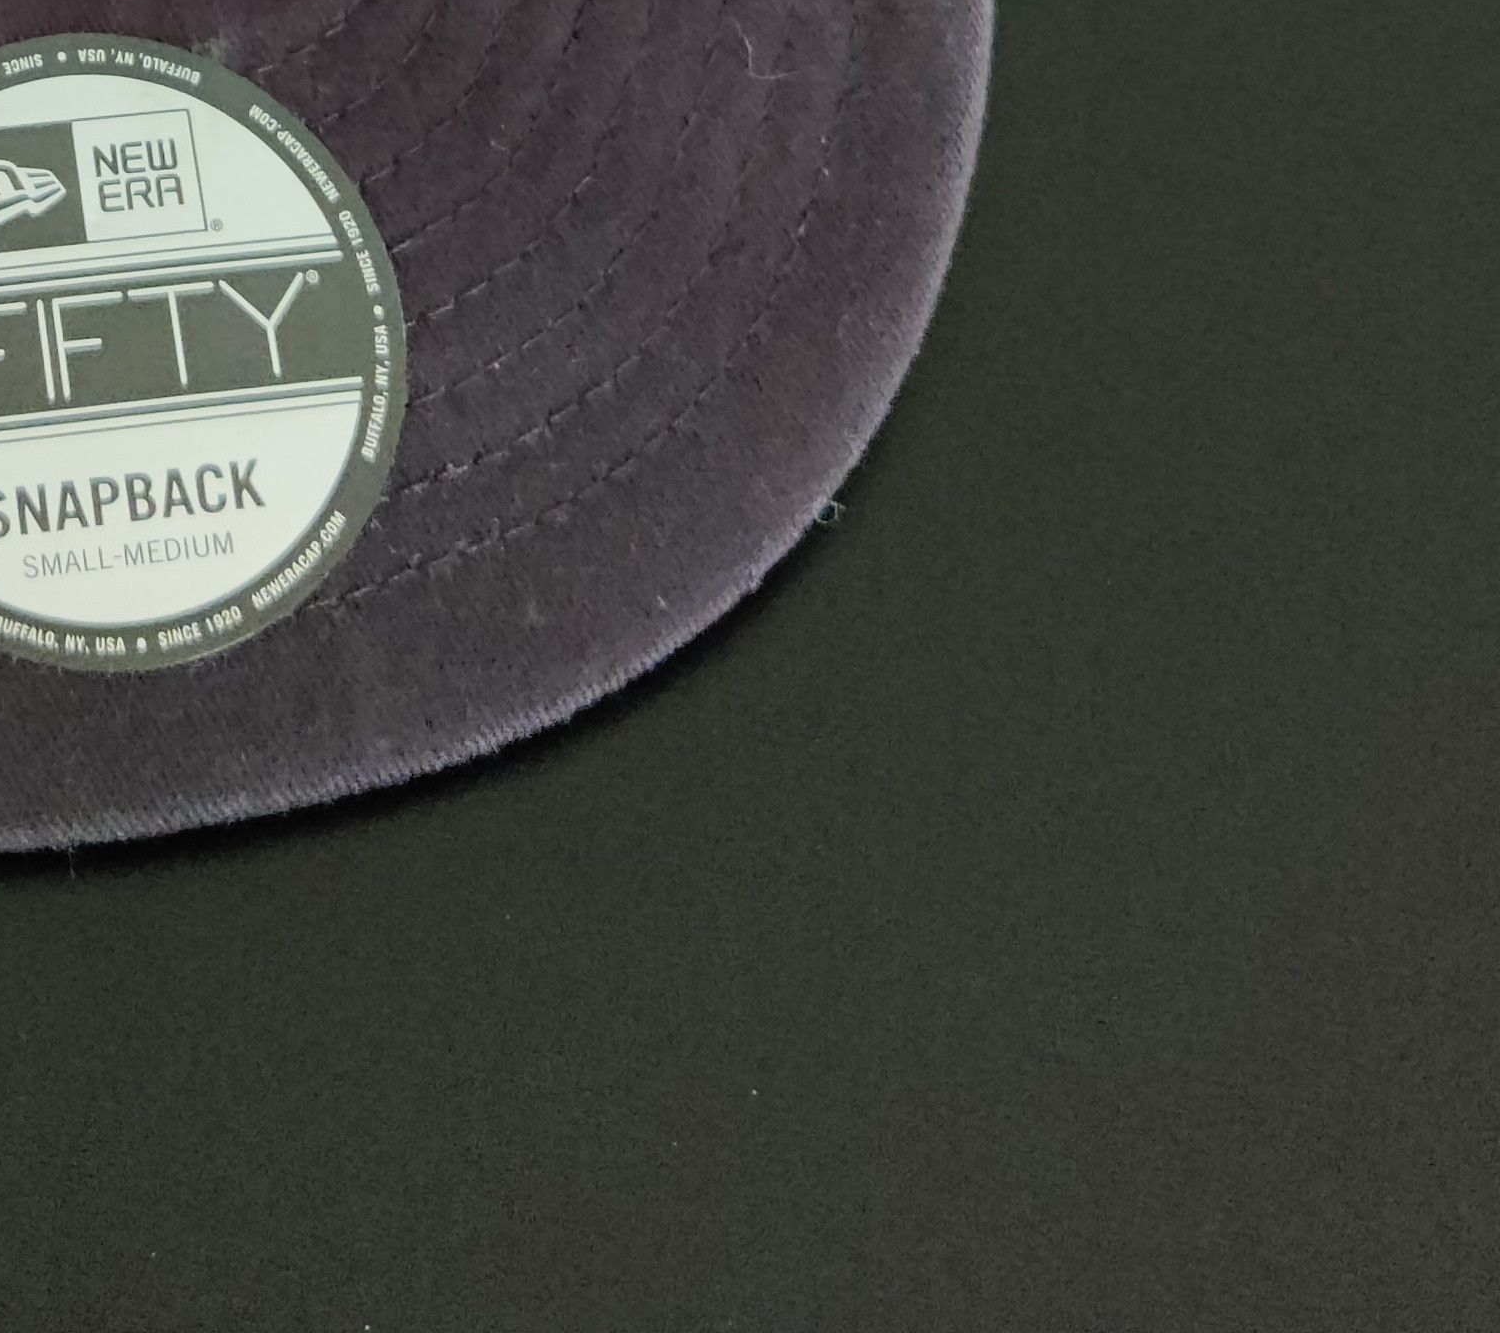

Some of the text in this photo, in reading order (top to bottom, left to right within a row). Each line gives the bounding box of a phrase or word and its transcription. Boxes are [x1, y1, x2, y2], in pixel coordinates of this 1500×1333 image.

[2, 53, 44, 76] SINCE
[77, 48, 107, 63] USA
[92, 137, 179, 178] NEW
[249, 104, 341, 204] NEWERACAP.COM
[97, 173, 185, 213] ERA
[338, 209, 364, 247] 1920
[356, 249, 381, 295] SINCE
[373, 324, 390, 356] USA
[23, 530, 235, 579] SMALL-MEDIUM
[96, 636, 126, 656] USA
[158, 621, 202, 652] SINCE
[205, 605, 244, 634] 1920
[251, 509, 347, 611] NEWERACAP.COM
